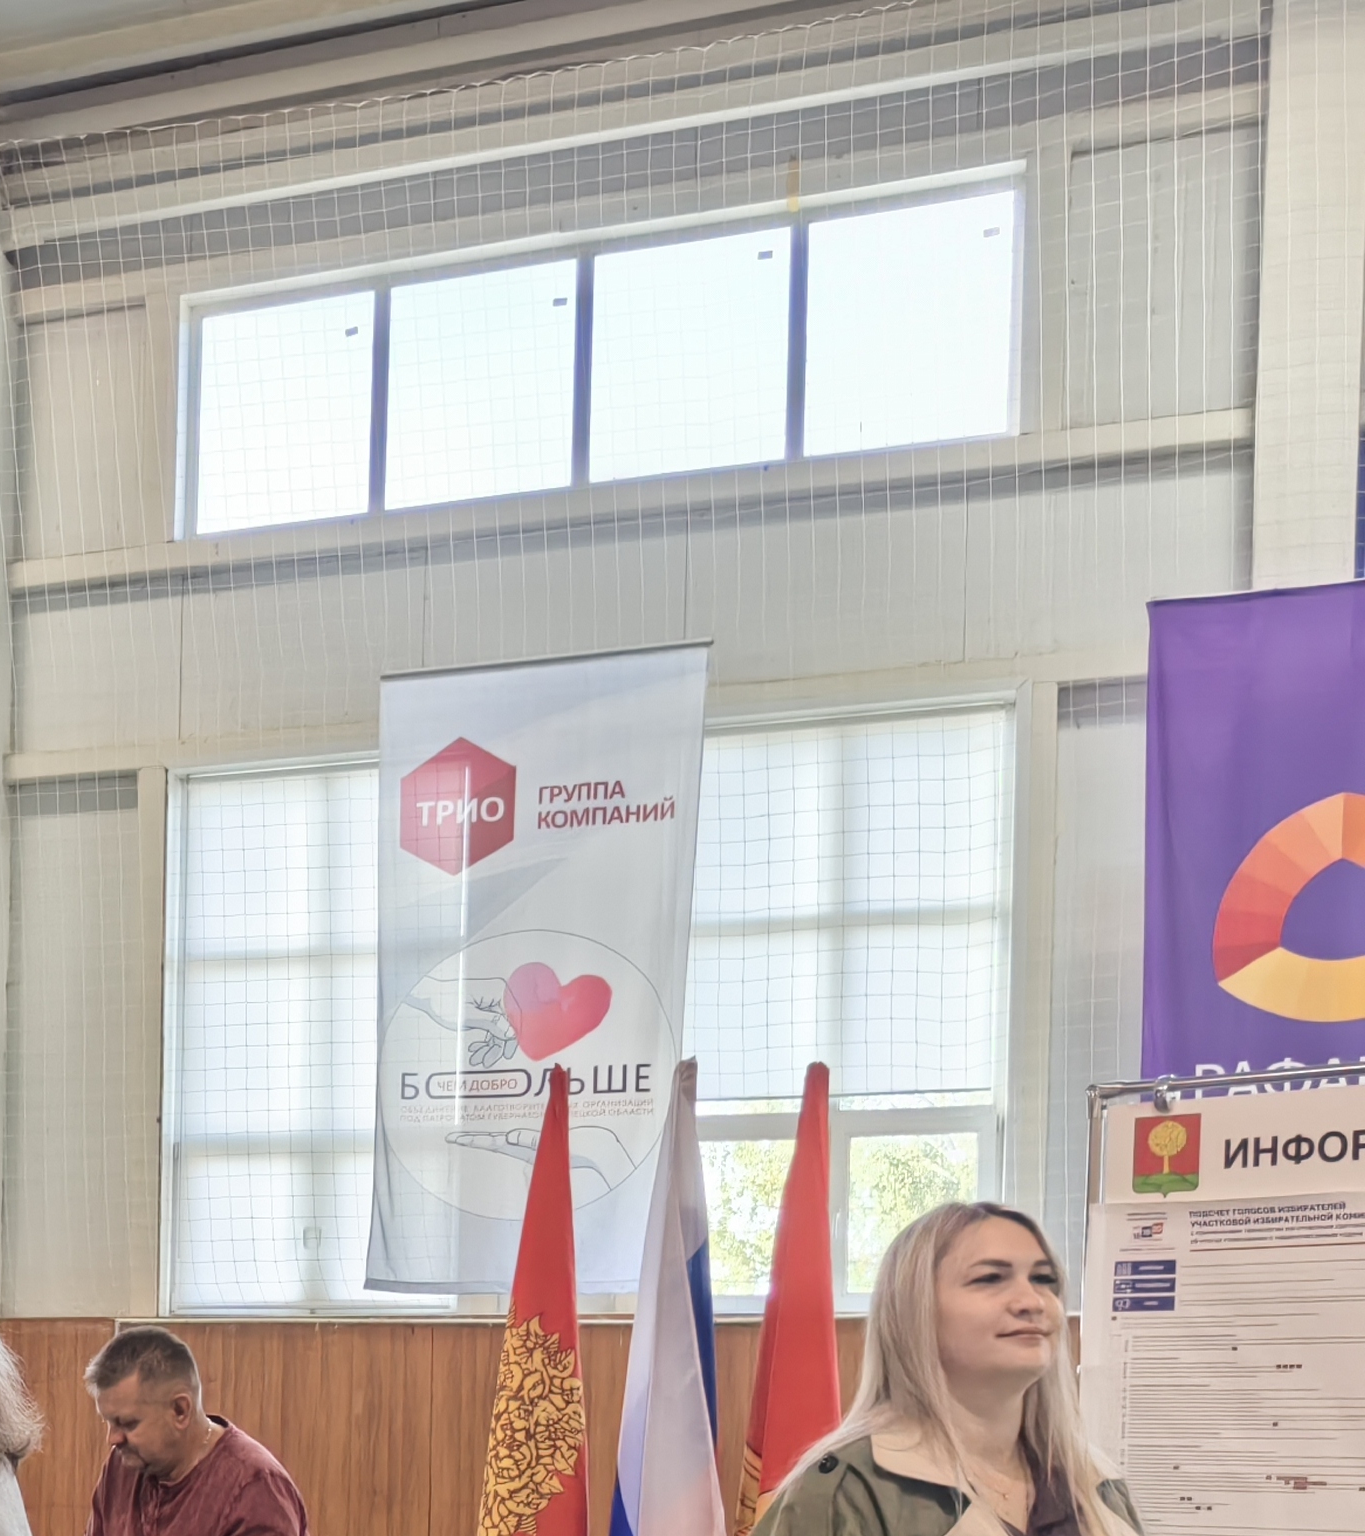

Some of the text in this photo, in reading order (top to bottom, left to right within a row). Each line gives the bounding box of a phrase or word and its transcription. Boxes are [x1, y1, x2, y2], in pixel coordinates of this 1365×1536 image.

[538, 780, 625, 804] ГРУППА
[416, 796, 505, 827] ТРИО
[537, 795, 675, 829] КОМПАНИЙ
[469, 1078, 518, 1092] ДОБРО
